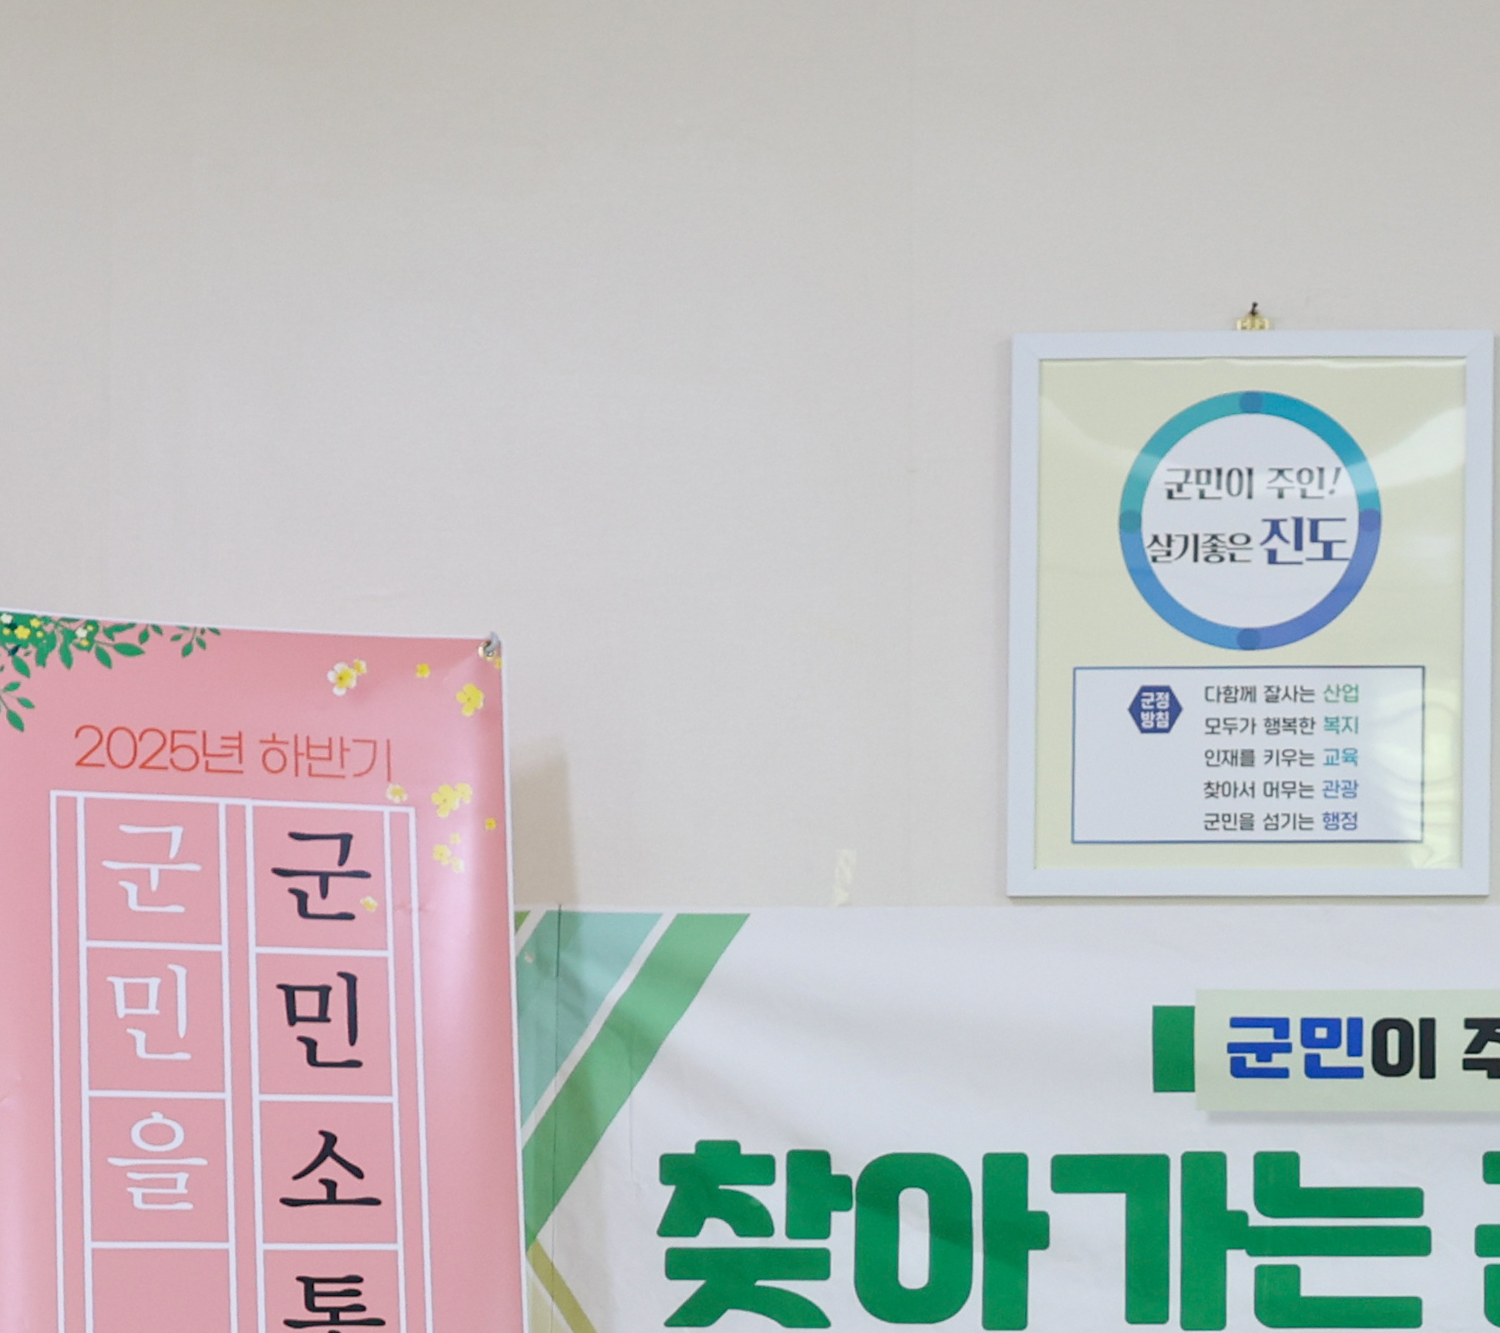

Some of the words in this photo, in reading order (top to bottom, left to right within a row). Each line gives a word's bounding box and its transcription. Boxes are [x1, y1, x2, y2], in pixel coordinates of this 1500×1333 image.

[1164, 466, 1254, 500] 군민이
[1266, 466, 1342, 500] 주인!
[1147, 532, 1253, 564] 살기좋은
[1260, 516, 1350, 565] 진도
[1140, 691, 1170, 709] 군정
[1204, 685, 1256, 703] 다함께
[1264, 685, 1315, 703] 잘사는
[1323, 684, 1359, 703] 산업
[1140, 710, 1170, 729] 방침
[1204, 717, 1256, 735] 모두가
[1264, 717, 1315, 735] 행복한
[1323, 716, 1359, 735] 복지
[74, 724, 245, 776] 2025년
[258, 733, 394, 782] 하반기
[1204, 748, 1256, 767] 인재를
[1264, 748, 1315, 767] 키우는
[1323, 747, 1359, 767] 교육
[1204, 780, 1256, 799] 찾아서
[1264, 780, 1315, 799] 머무는
[1323, 779, 1359, 799] 관광
[1204, 812, 1256, 831] 군민을
[1264, 812, 1315, 831] 섬기는
[1323, 811, 1359, 831] 행정
[102, 822, 208, 1214] 군민을
[1228, 1016, 1436, 1080] 군민이
[657, 1140, 1432, 1331] 찾아가는
